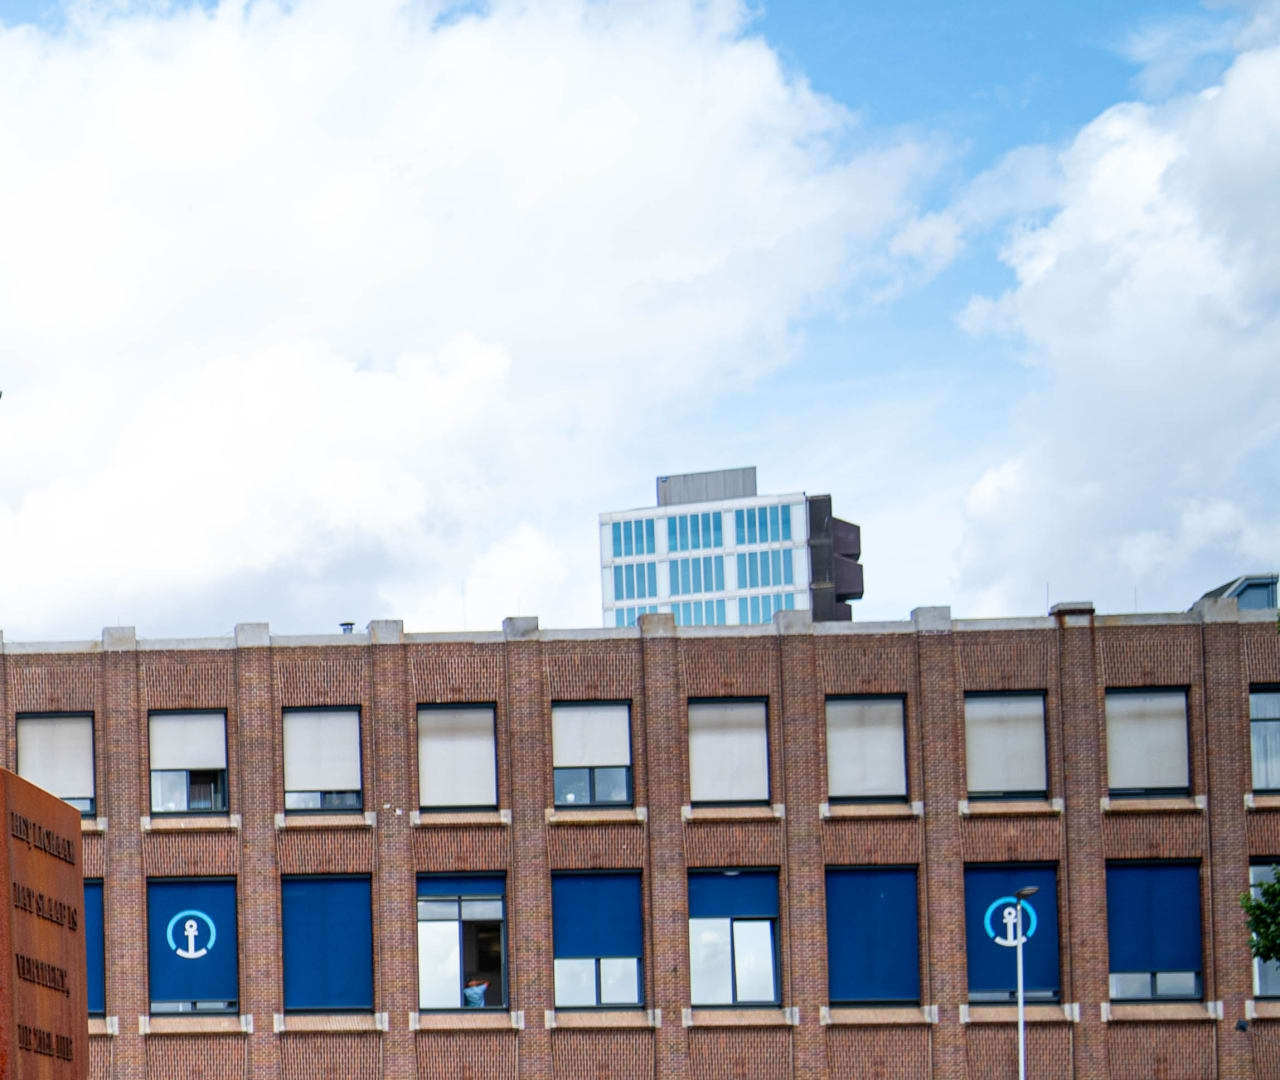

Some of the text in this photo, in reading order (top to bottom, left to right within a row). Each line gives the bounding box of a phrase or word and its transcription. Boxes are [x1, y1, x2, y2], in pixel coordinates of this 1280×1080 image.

[13, 882, 77, 932] DAT SLAAF IS
